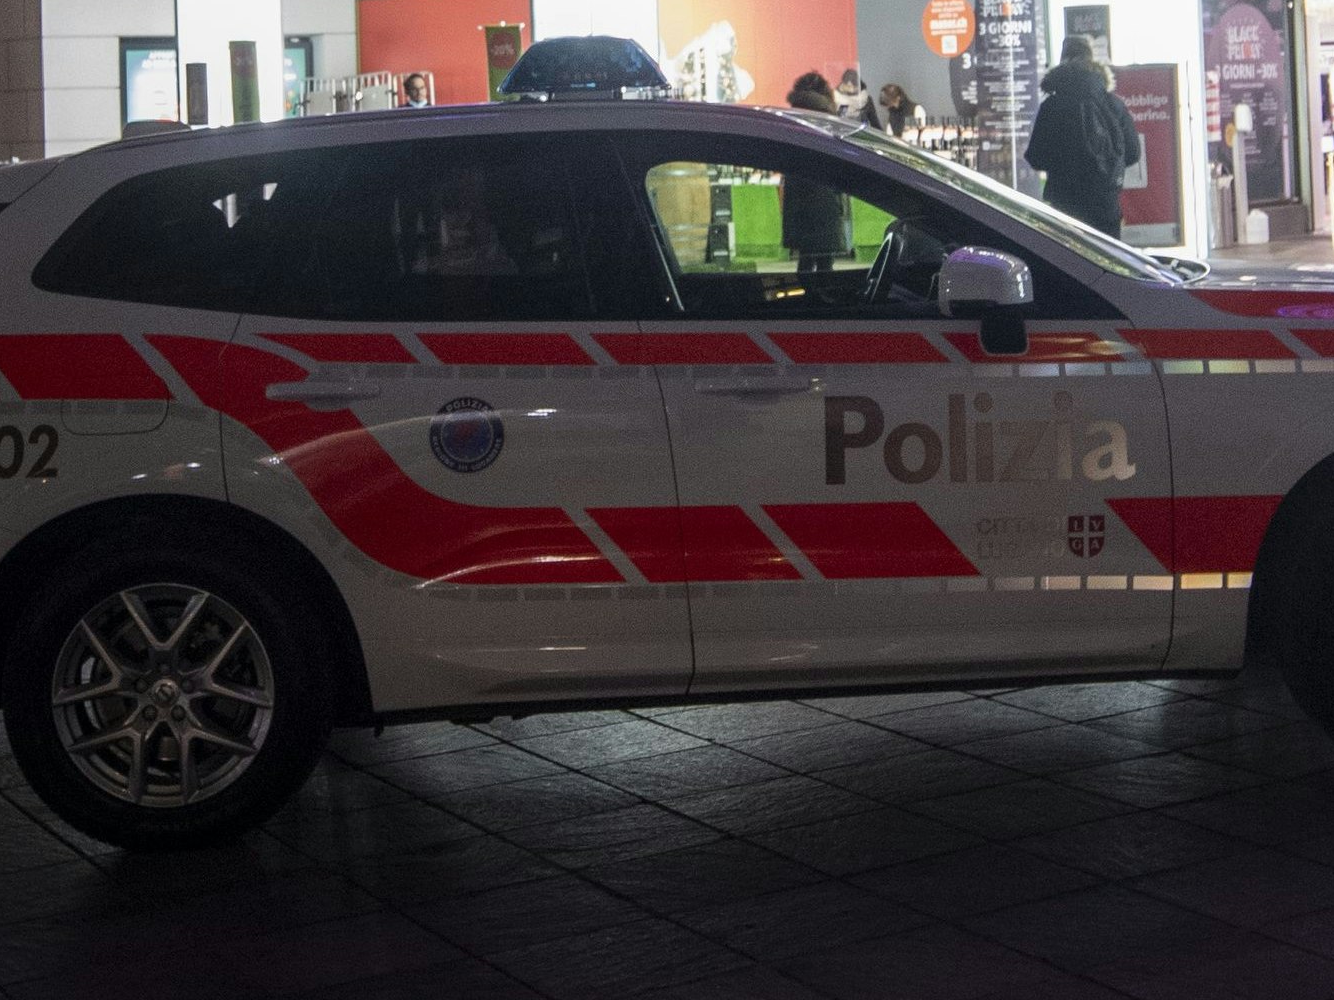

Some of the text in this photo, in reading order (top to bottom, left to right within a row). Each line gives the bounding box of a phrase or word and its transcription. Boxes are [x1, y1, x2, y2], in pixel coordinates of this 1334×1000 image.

[979, 19, 1032, 36] 3 GIORNI
[1222, 63, 1255, 81] GIORNI
[824, 391, 1137, 485] Polizia
